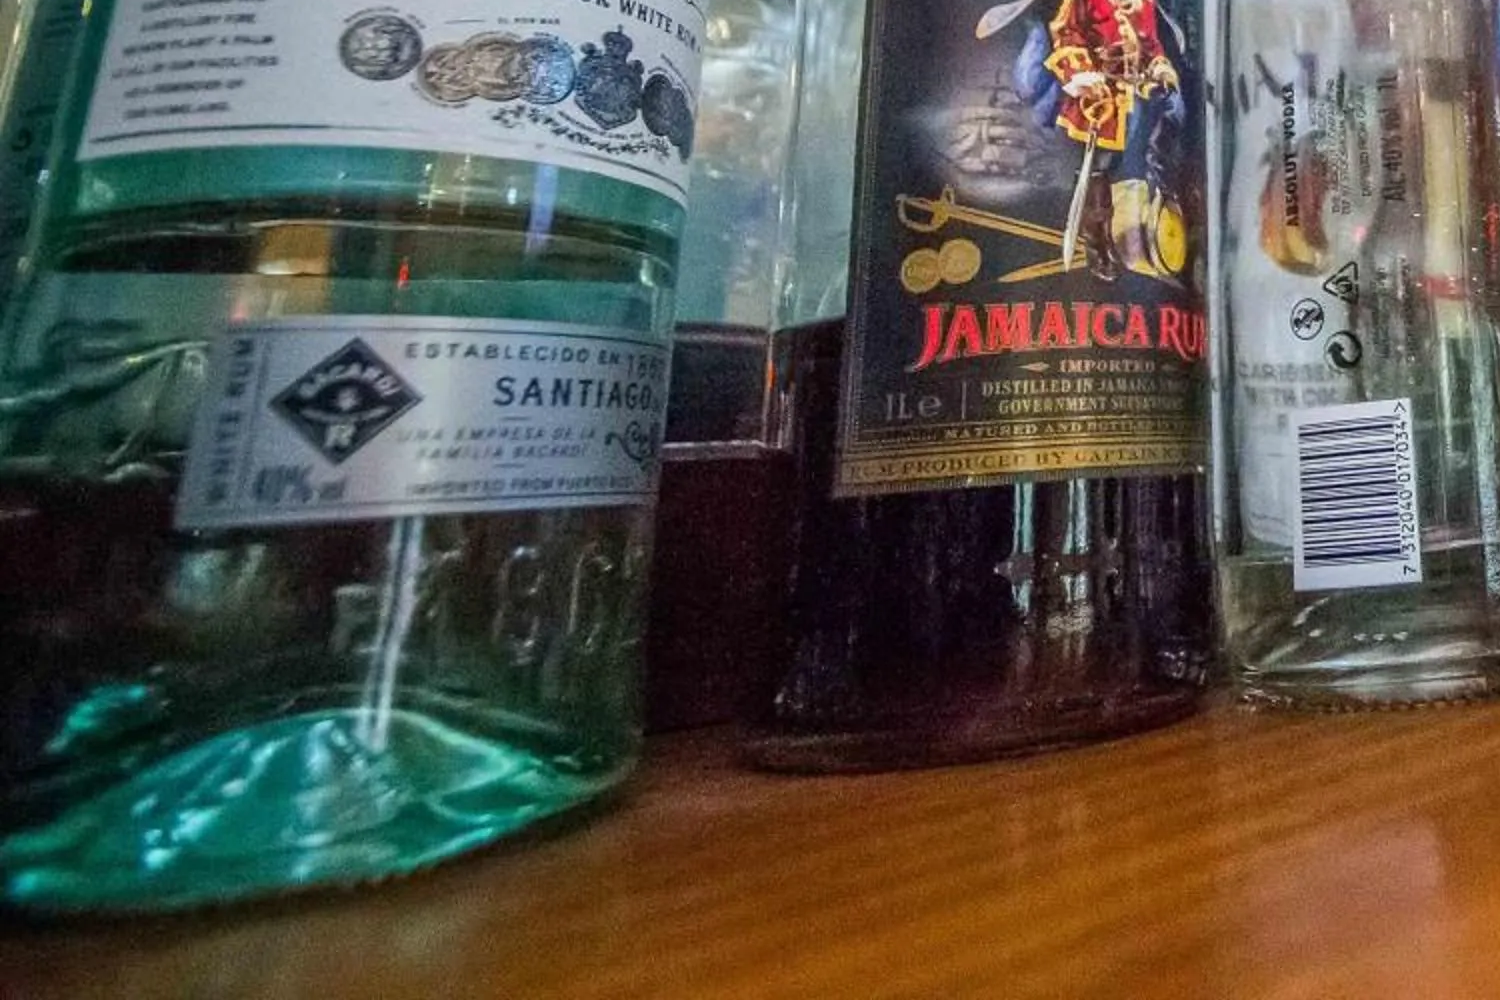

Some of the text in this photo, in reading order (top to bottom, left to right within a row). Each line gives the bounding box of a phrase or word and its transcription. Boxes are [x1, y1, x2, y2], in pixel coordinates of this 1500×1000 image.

[1281, 81, 1299, 228] ABSOLUT VODKA
[904, 301, 1151, 373] JAMAICA
[404, 342, 590, 363] ESTABLECIDO
[597, 349, 620, 365] EN
[1058, 358, 1155, 374] IMPORTED
[493, 375, 652, 411] SANTIAGO
[981, 377, 1071, 397] DISTILLED
[1076, 378, 1093, 394] IN
[998, 395, 1107, 415] GOVERNMENT
[943, 423, 1038, 440] MATURED
[1044, 422, 1083, 436] AND
[899, 451, 1026, 475] PRODUCED
[1395, 420, 1417, 577] 7 312040 017034
